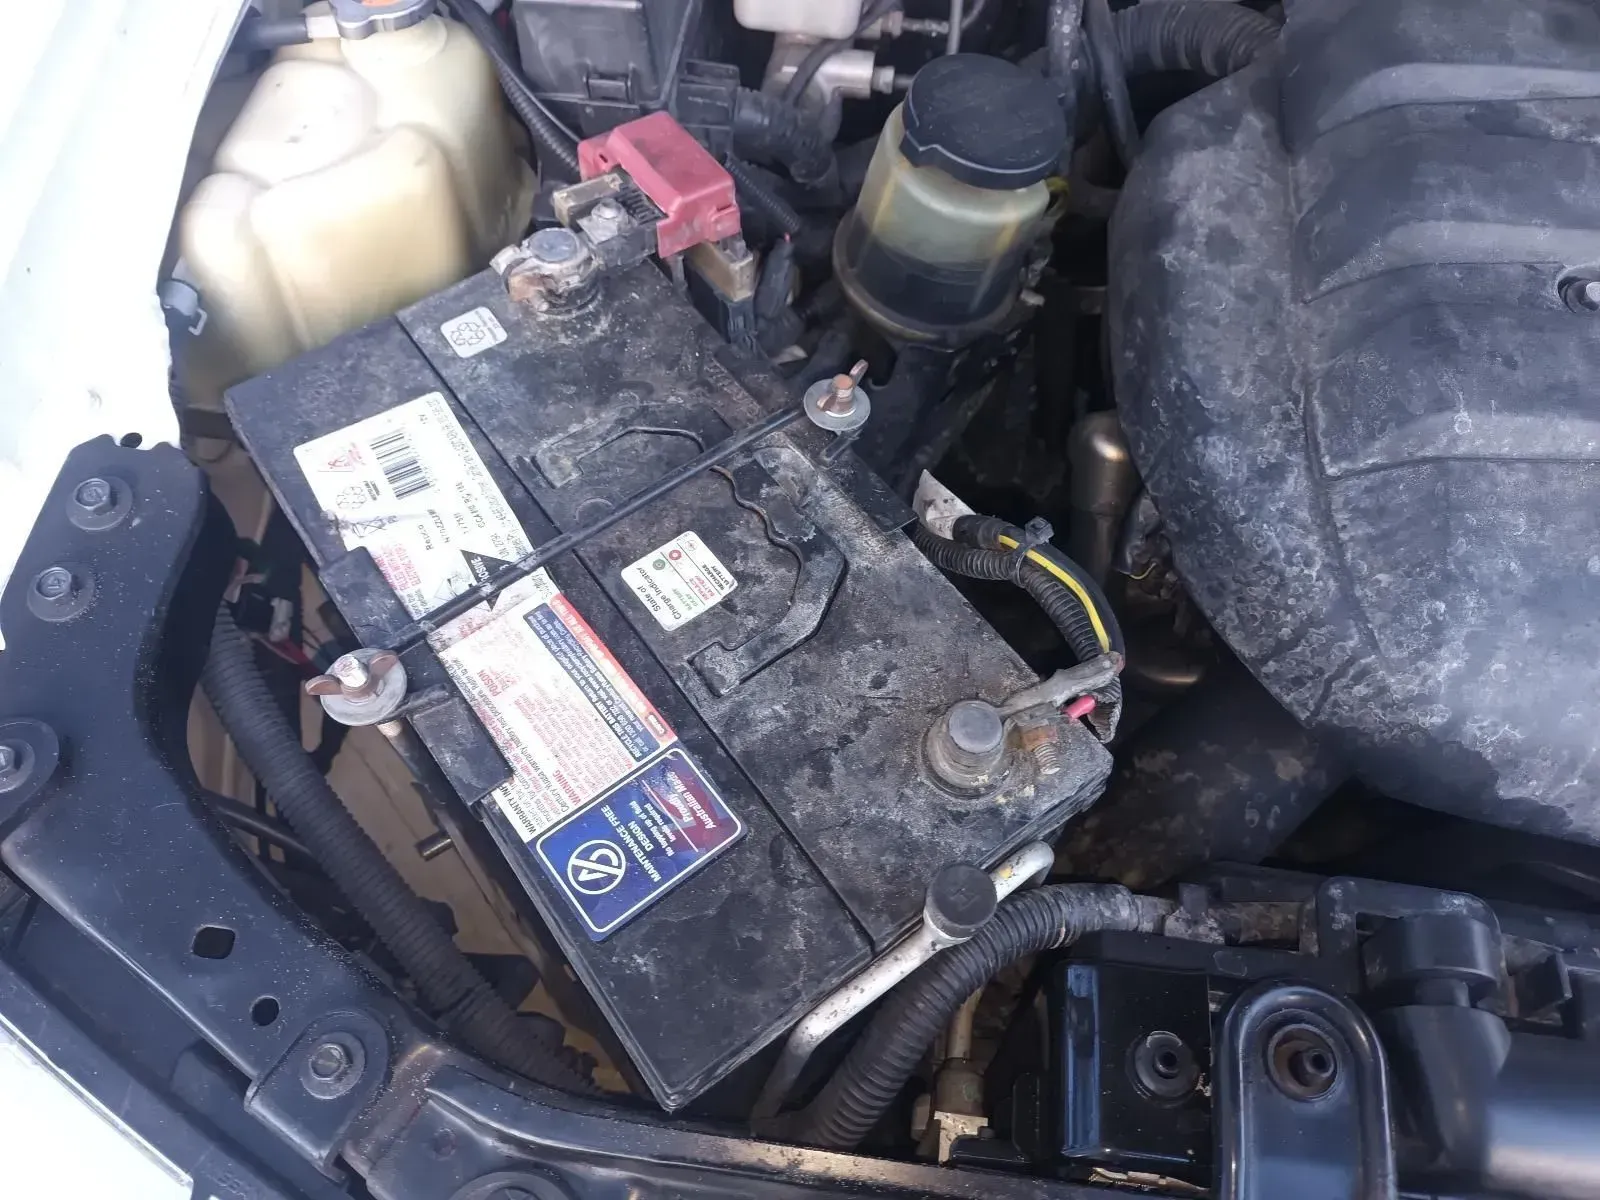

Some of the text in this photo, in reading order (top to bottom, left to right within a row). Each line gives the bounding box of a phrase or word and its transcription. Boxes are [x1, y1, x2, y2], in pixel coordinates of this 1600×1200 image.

[701, 563, 724, 590] RECHARGE
[635, 565, 682, 620] Charge Indicator
[636, 584, 661, 612] State of
[475, 667, 502, 698] POISON
[594, 699, 616, 725] BATTERY
[503, 725, 524, 748] battery
[611, 721, 625, 736] THIS
[517, 744, 542, 773] warranty
[620, 732, 642, 759] RECYCLE
[535, 770, 553, 790] Yuasa
[551, 768, 582, 806] WARNING
[547, 786, 571, 813] Century
[667, 791, 694, 823] Proudly
[681, 789, 716, 831] Australian
[505, 795, 538, 835] WARRANTY
[643, 817, 654, 828] up
[600, 803, 662, 882] MAINTENANCE FREE
[627, 819, 654, 851] DESIGN
[648, 825, 669, 848] topping
[663, 845, 674, 857] No
